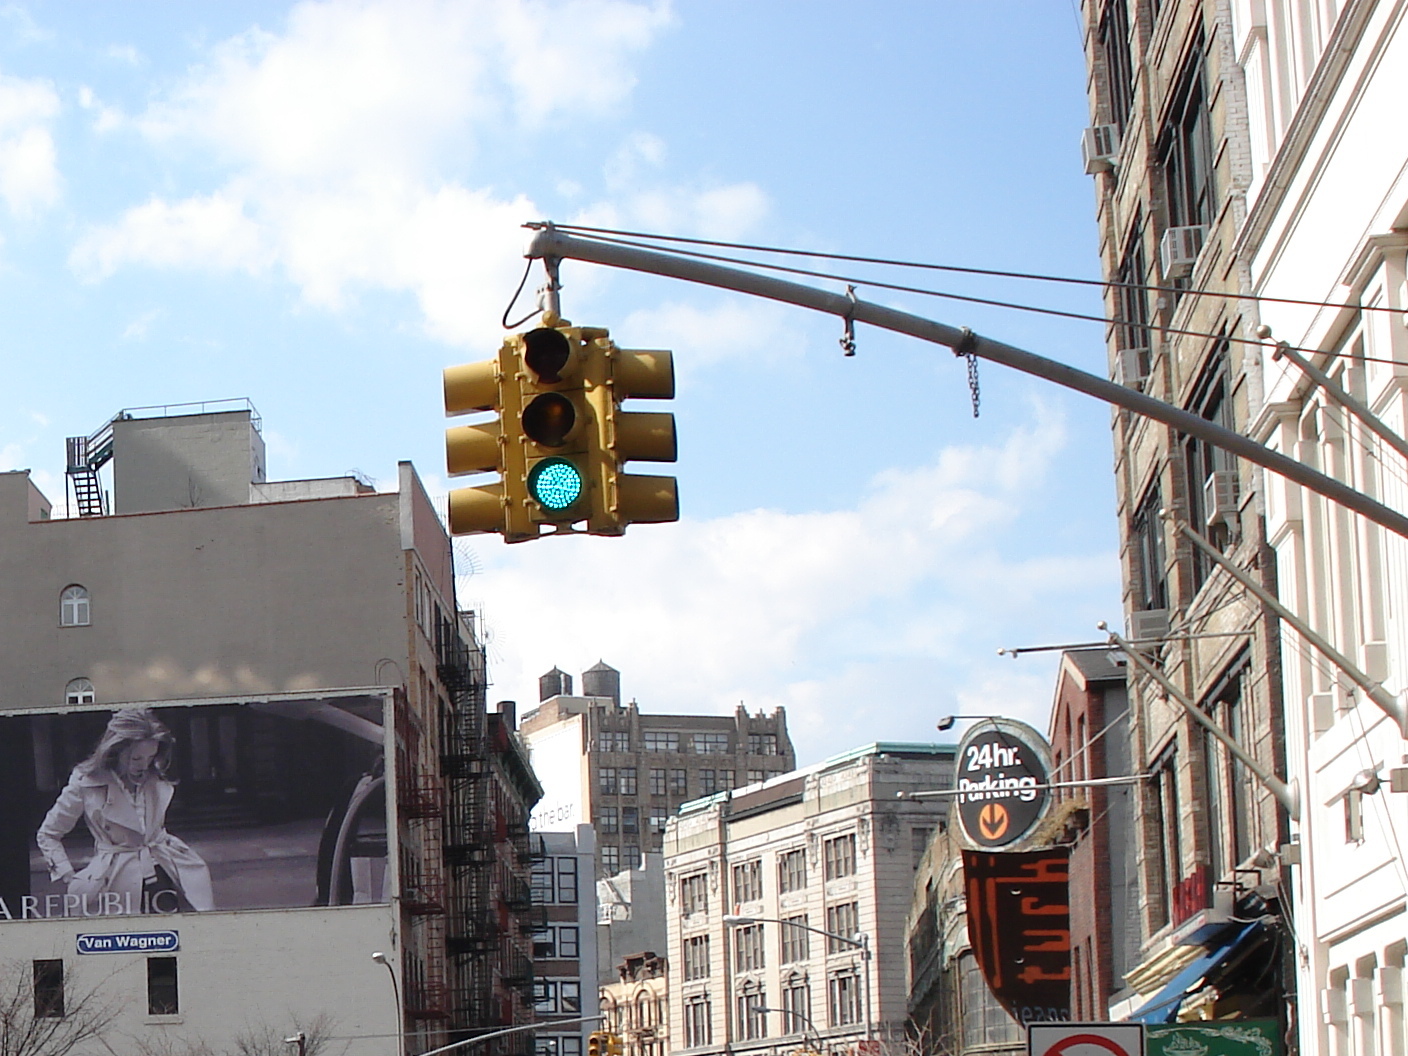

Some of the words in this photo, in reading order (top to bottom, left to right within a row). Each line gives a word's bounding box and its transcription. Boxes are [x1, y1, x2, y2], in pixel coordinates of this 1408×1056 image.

[967, 743, 1022, 772] 24hr.
[959, 773, 1037, 804] Parking
[21, 889, 178, 920] REPUBLIC
[84, 937, 112, 949] Van
[115, 935, 172, 949] Wagner
